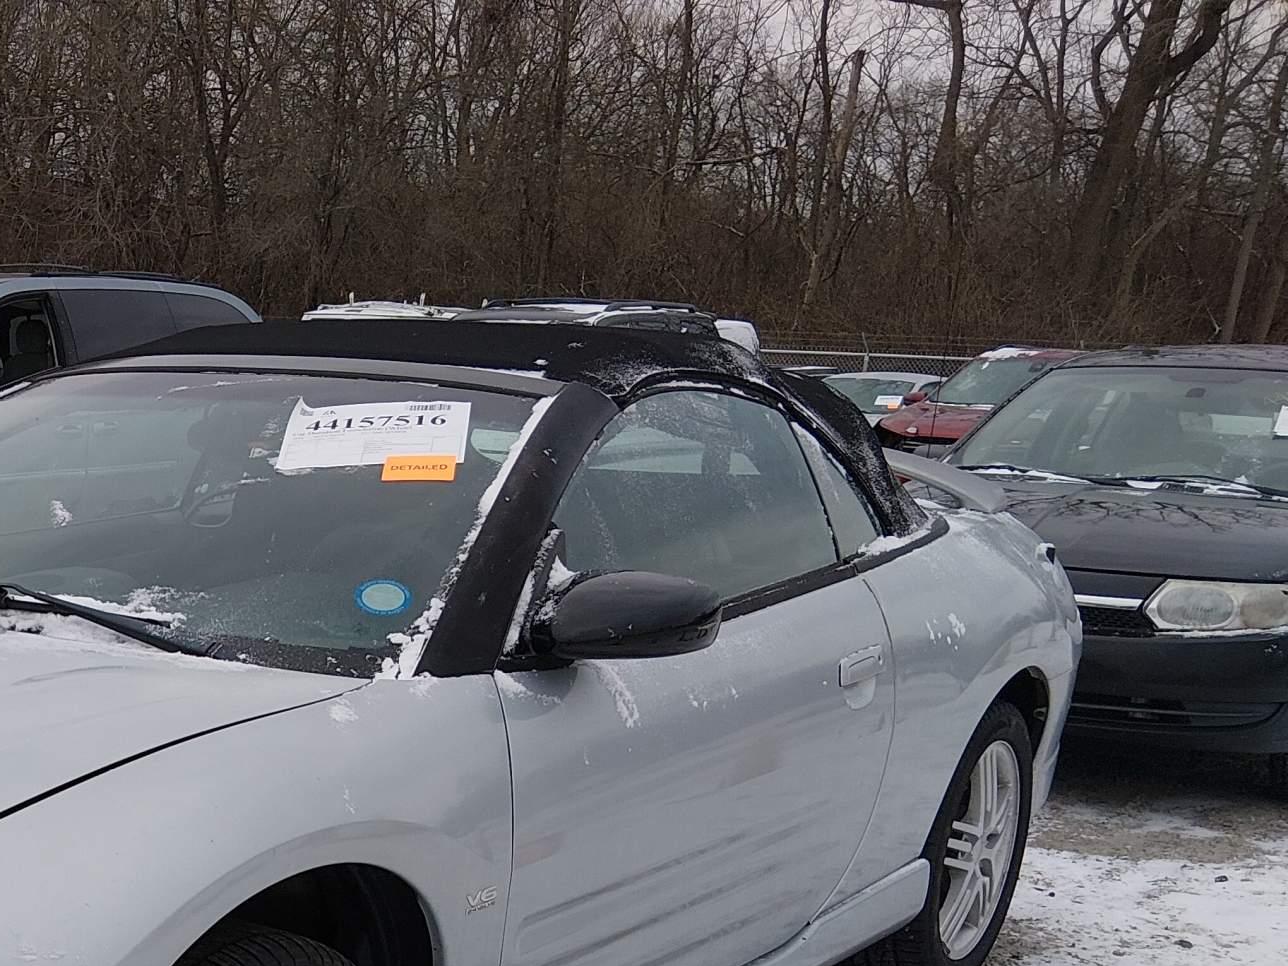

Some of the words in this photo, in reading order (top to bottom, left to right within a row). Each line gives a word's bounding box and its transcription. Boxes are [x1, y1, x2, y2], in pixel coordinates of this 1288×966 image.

[304, 414, 448, 431] 44157516
[390, 463, 448, 471] DETAILED
[466, 886, 497, 908] V6
